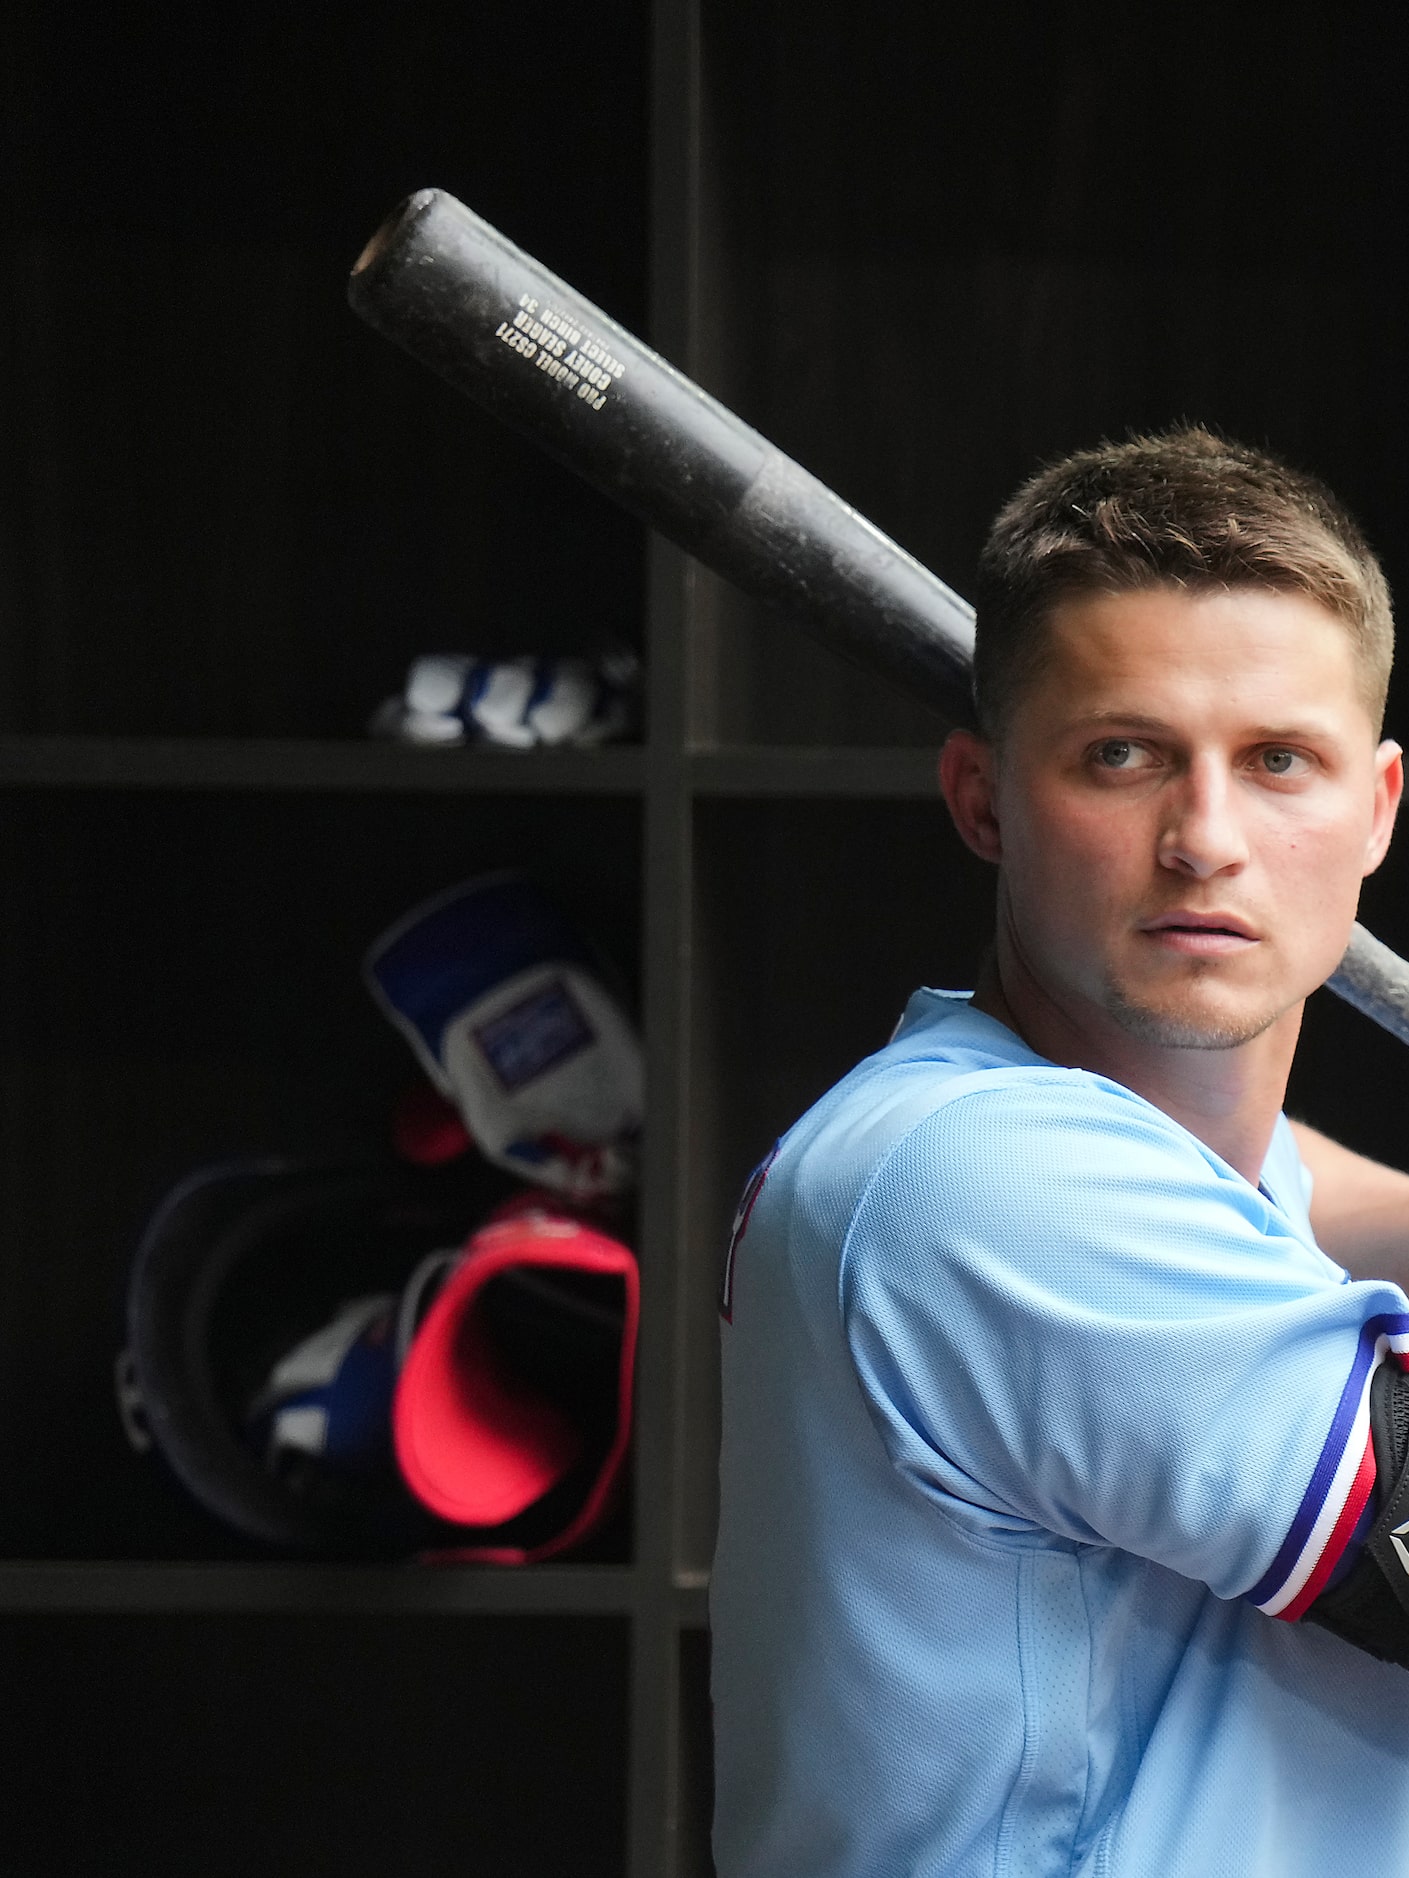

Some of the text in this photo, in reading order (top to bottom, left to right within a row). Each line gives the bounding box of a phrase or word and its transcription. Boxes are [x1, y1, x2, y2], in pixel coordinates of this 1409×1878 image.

[519, 293, 539, 314] 34
[495, 321, 538, 359] CS271
[513, 310, 567, 357] SEAGER
[540, 309, 581, 346] BIRCH
[535, 350, 580, 390] MODEL
[564, 350, 612, 391] COREY
[580, 339, 626, 379] SELECT
[577, 382, 607, 411] PRO
